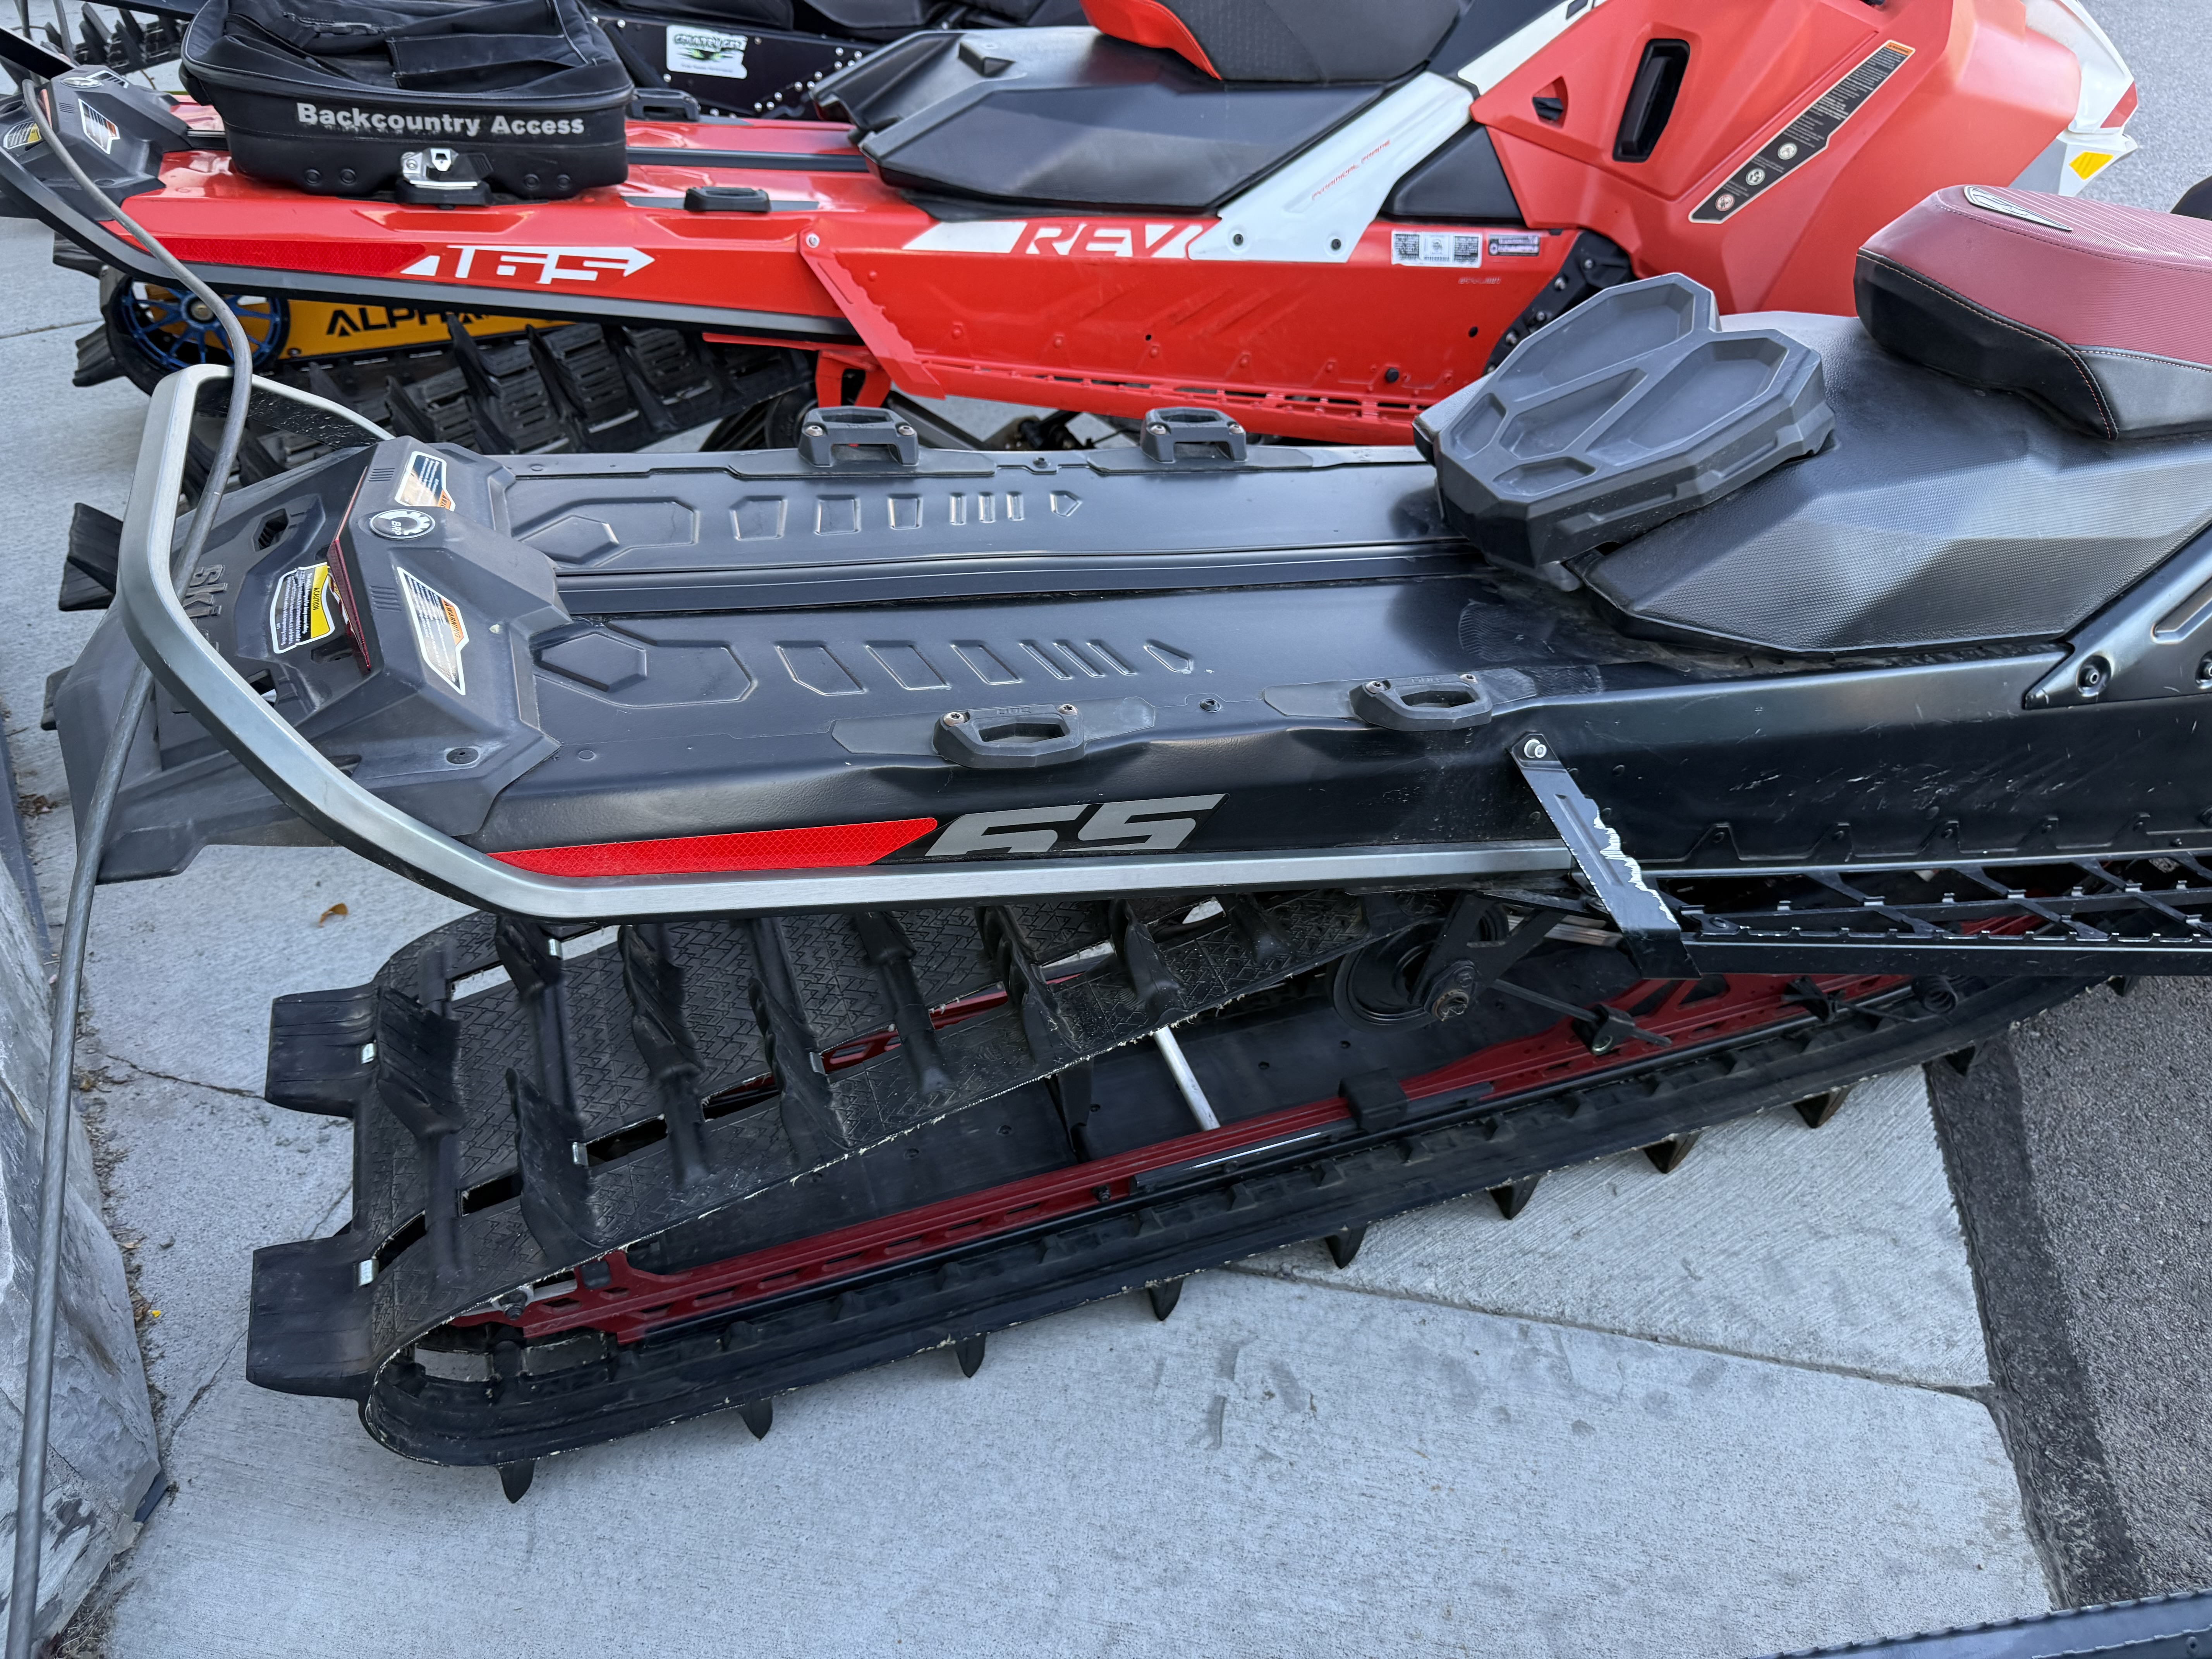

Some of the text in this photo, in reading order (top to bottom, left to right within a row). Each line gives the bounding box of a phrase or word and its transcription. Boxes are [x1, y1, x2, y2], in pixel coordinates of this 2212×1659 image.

[297, 103, 584, 137] Backcountry Access
[1009, 221, 1191, 259] REV
[391, 520, 402, 536] BRP
[313, 590, 321, 611] CAUTION
[446, 606, 461, 638] WARNING
